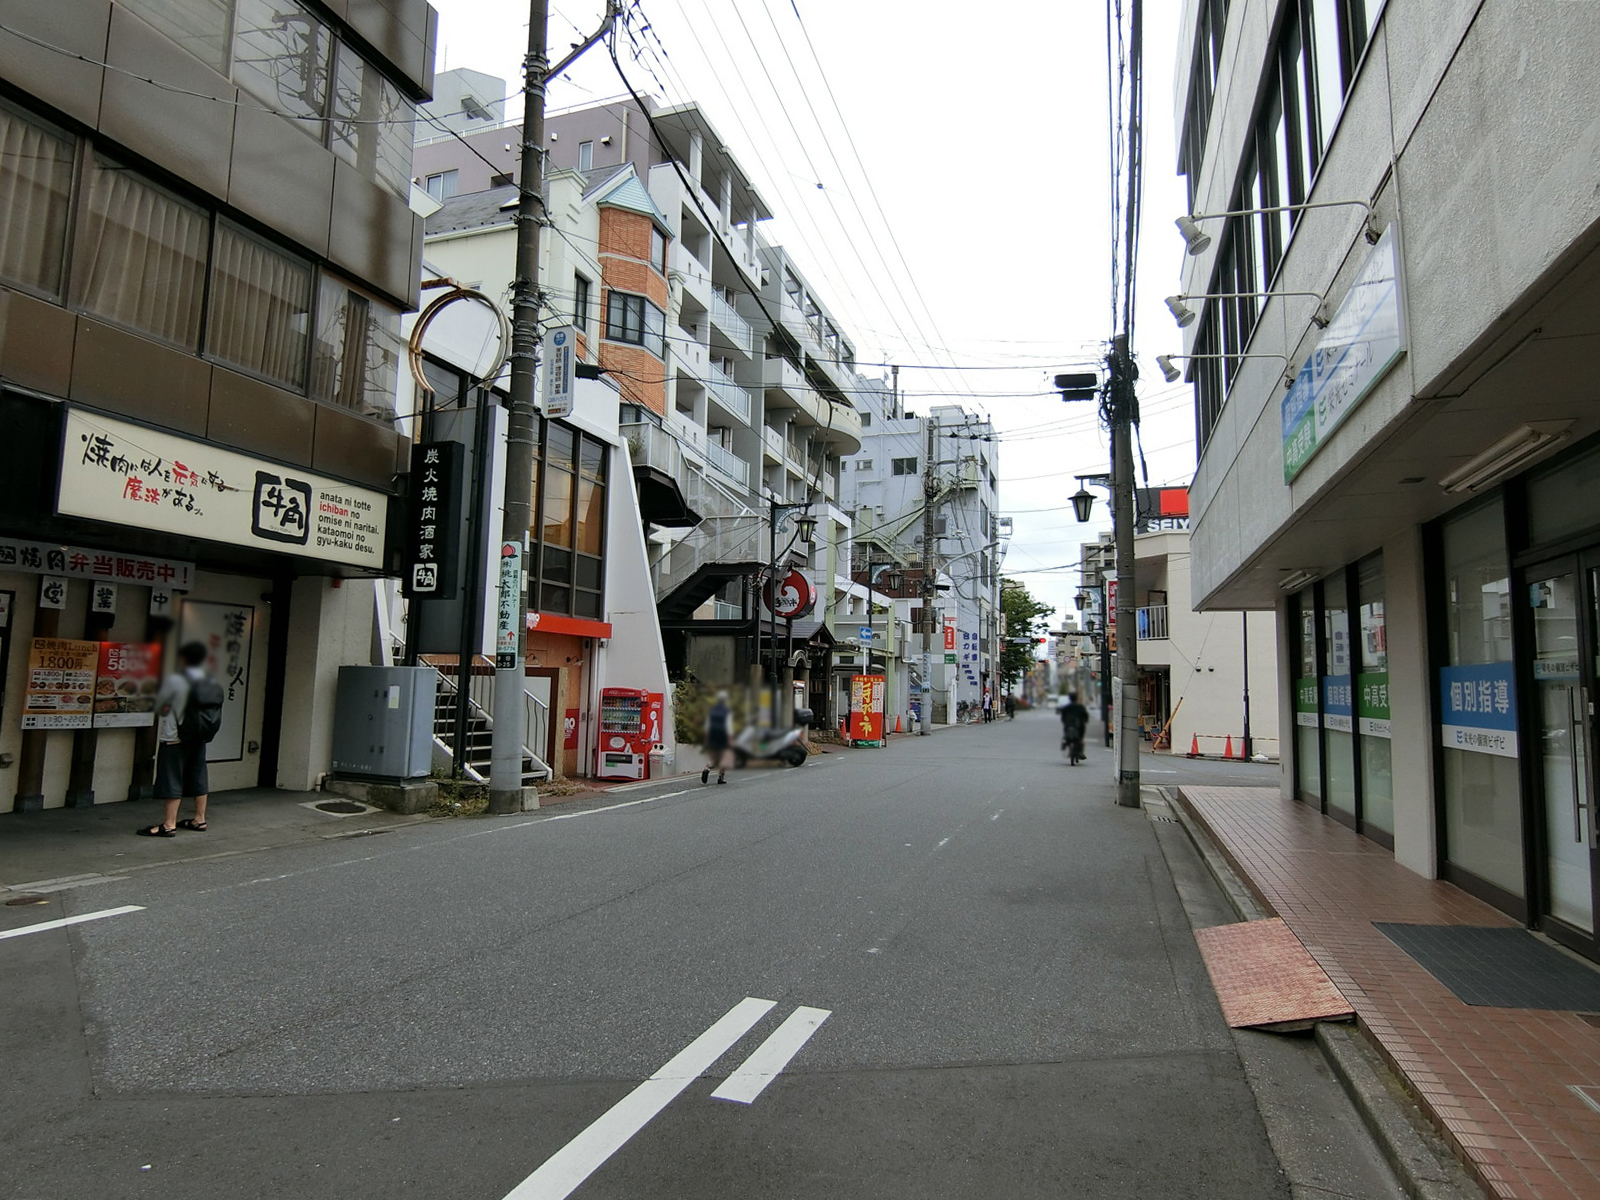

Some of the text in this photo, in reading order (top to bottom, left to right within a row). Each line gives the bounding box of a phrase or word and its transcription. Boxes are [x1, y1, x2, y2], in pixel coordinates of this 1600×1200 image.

[319, 501, 360, 519] ichiban no
[320, 491, 372, 512] anata ni totte
[419, 449, 440, 559] 炭火焼肉酒家
[317, 524, 365, 543] kataomoi no
[318, 515, 380, 535] omise ni naritai.
[316, 535, 375, 554] gyu-kaku desu.
[153, 593, 169, 611] 中
[1364, 684, 1389, 707] 中高受
[1450, 680, 1509, 714] 個別指導
